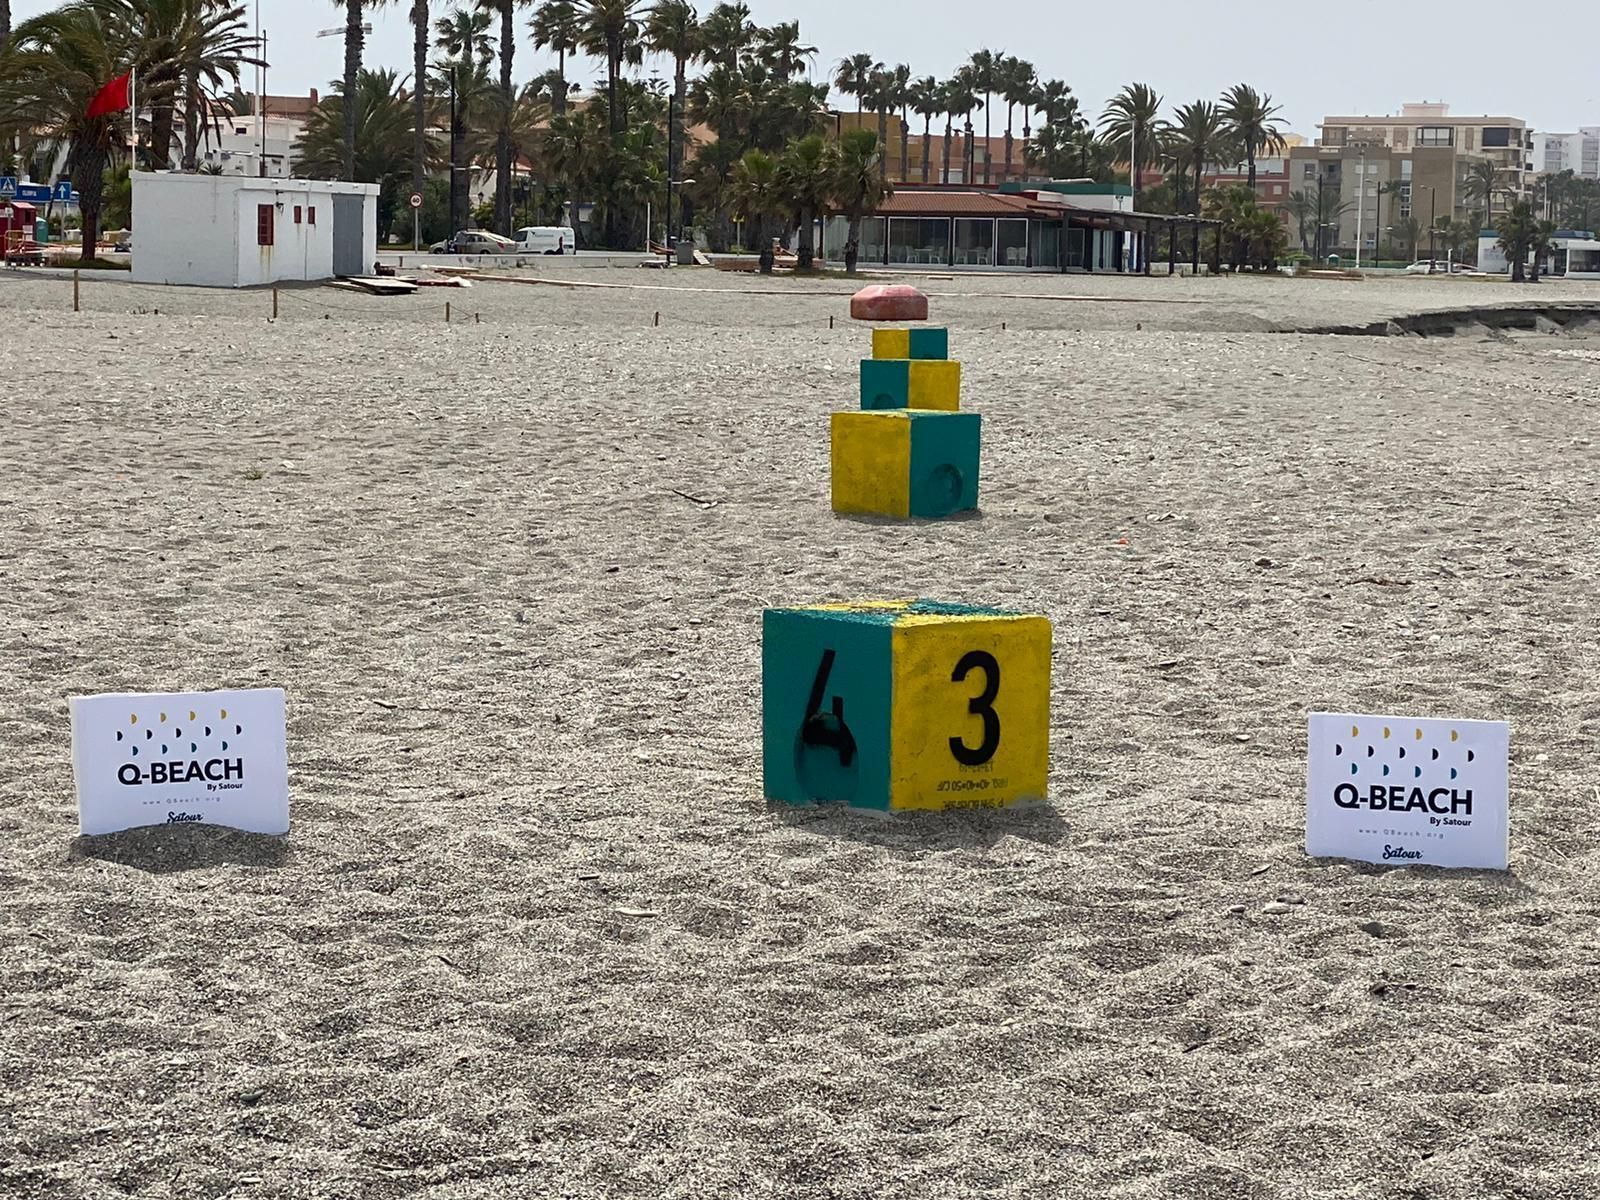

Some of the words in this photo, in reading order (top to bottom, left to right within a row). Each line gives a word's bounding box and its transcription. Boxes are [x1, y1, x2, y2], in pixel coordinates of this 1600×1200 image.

[801, 648, 857, 768] 4
[948, 649, 1001, 767] 3
[117, 758, 243, 785] Q-BEACH
[207, 783, 217, 792] By
[218, 782, 243, 790] Satour
[1333, 783, 1473, 815] Q-BEACH
[166, 811, 203, 823] Satour
[1429, 816, 1440, 827] By
[1443, 817, 1472, 826] Satour
[1382, 844, 1422, 859] Satour
